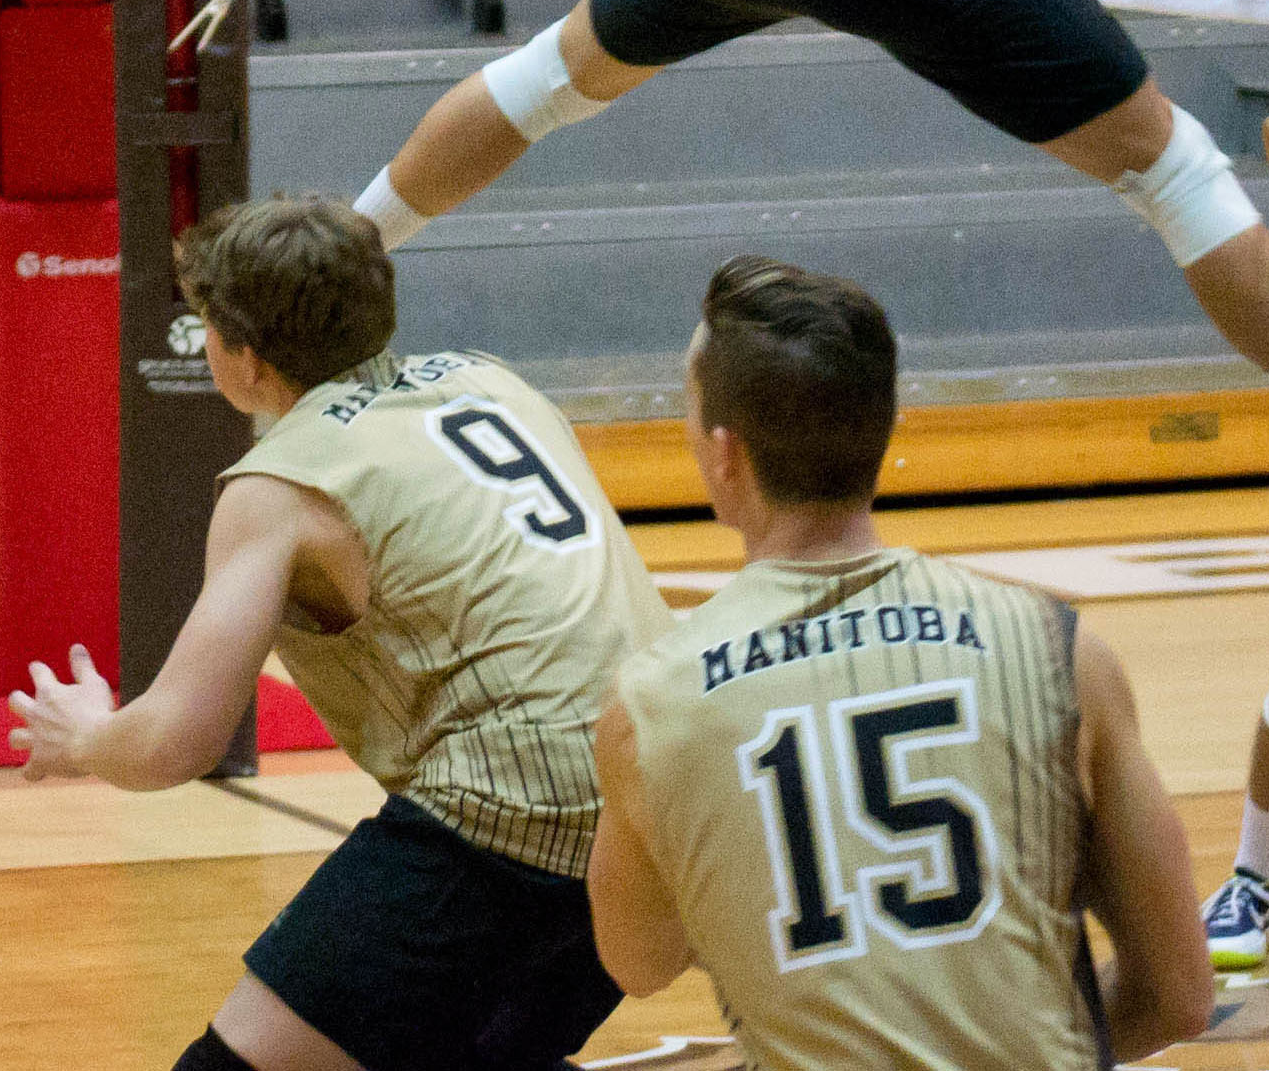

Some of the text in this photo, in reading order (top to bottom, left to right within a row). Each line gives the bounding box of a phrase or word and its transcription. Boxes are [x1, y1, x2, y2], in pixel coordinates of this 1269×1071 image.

[42, 253, 122, 277] Seno
[427, 396, 601, 551] 9
[701, 605, 986, 696] MANITOBA
[736, 678, 1002, 973] 15
